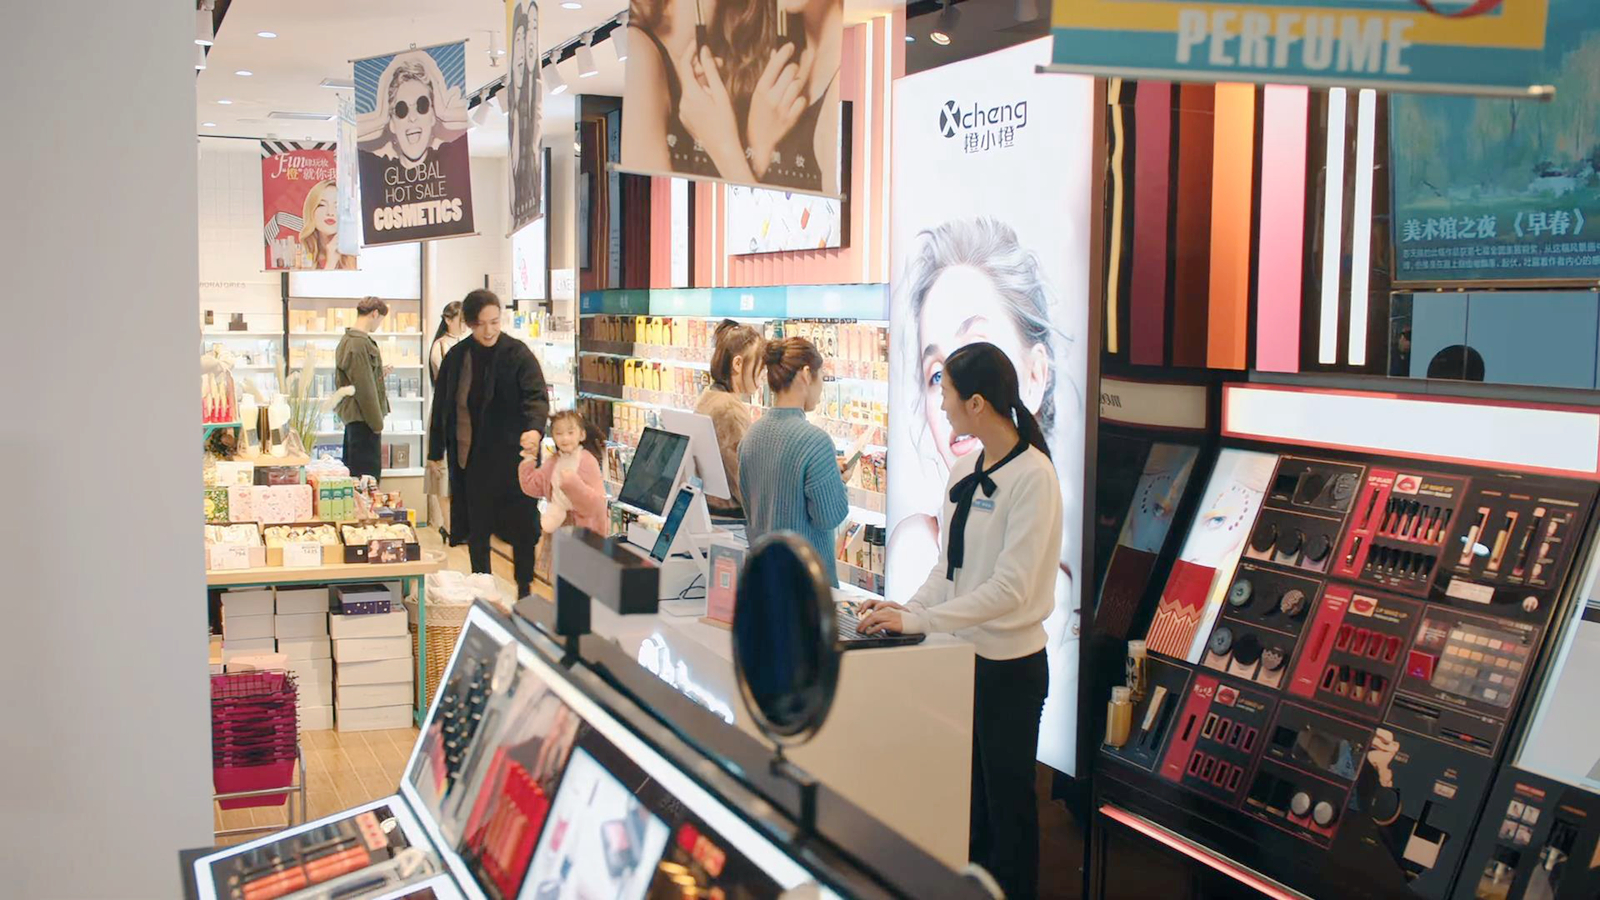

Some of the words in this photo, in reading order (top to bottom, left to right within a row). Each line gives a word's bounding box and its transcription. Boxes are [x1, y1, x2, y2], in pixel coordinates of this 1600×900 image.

[1176, 9, 1415, 75] PERFUME
[384, 160, 447, 186] GLOBAL
[385, 185, 413, 204] HOT
[415, 180, 448, 200] SALE
[373, 197, 463, 231] COSMETICS
[1402, 214, 1497, 242] 美术馆之夜
